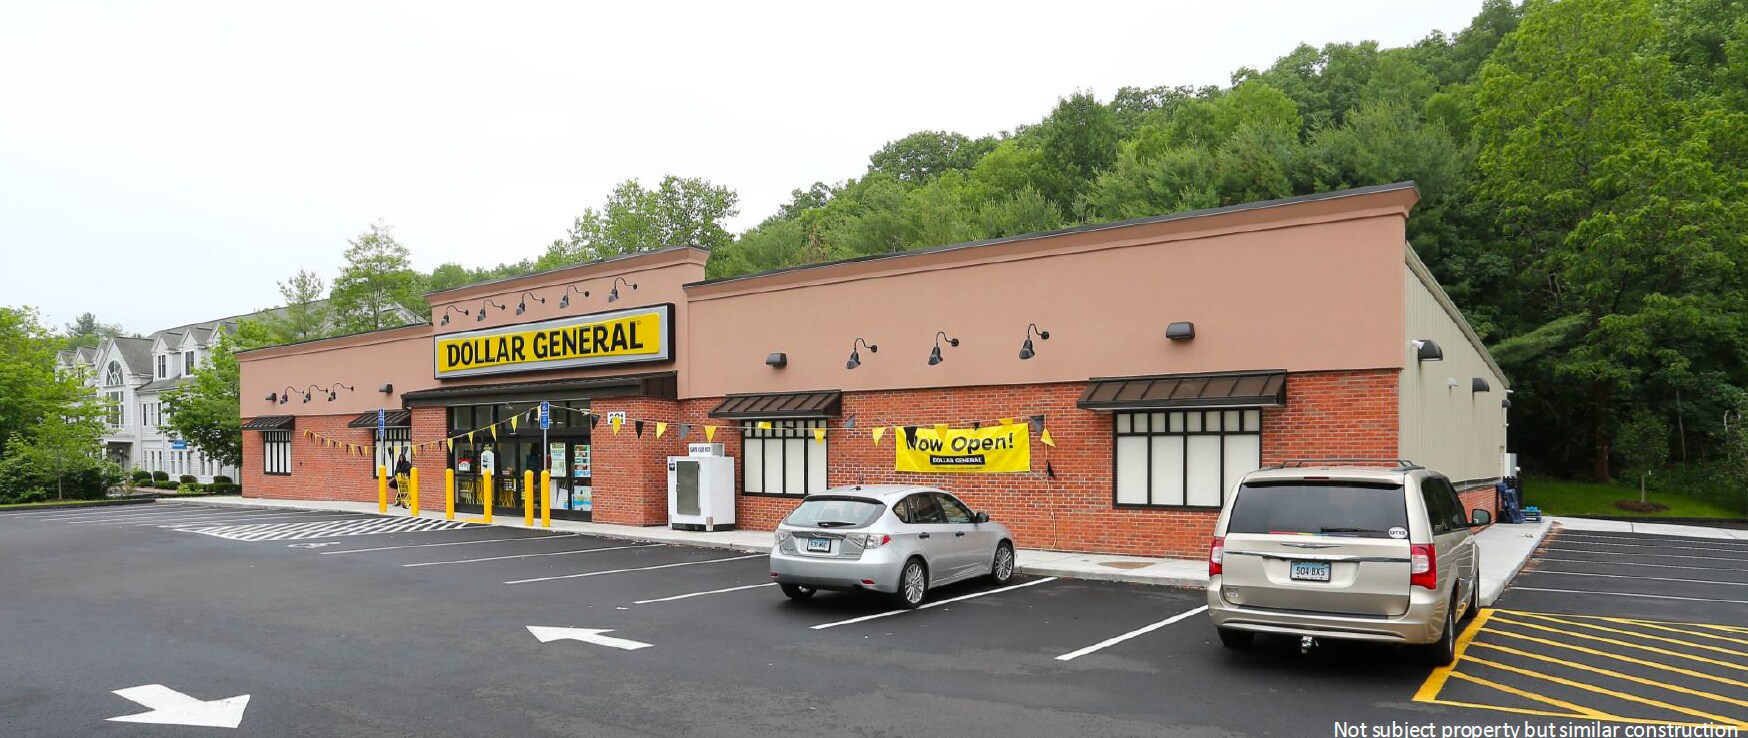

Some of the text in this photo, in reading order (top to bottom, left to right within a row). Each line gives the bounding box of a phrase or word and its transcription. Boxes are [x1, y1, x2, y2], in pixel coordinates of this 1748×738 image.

[447, 321, 644, 367] DOLLAR GENERAL
[951, 432, 1014, 455] Open!
[955, 456, 983, 464] GENERAL
